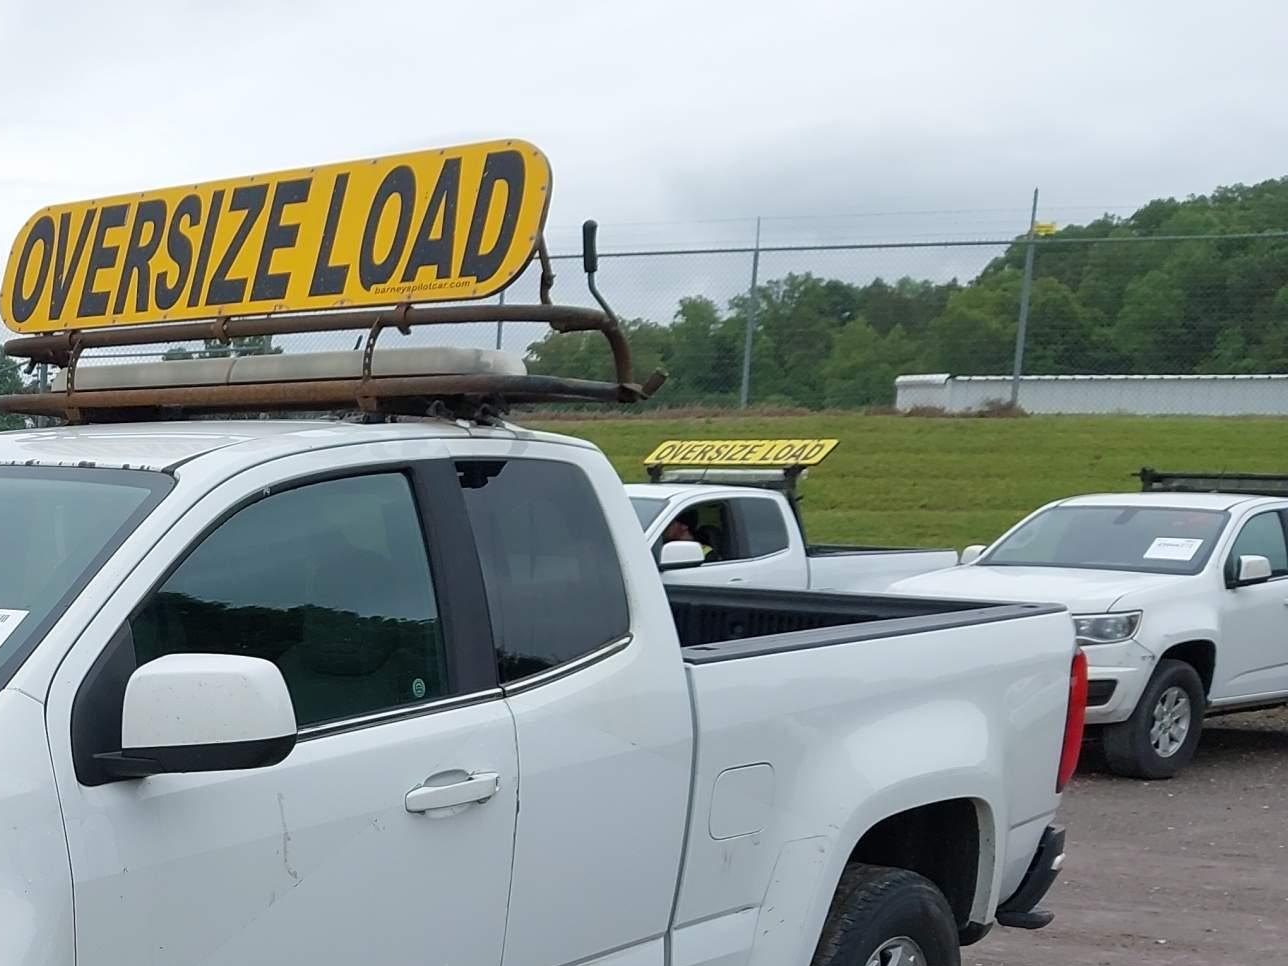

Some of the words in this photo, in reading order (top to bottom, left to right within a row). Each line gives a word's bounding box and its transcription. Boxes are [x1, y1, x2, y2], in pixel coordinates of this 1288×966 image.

[11, 177, 314, 324] OVERSIZE
[307, 149, 527, 297] LOAD
[373, 279, 471, 295] barneyspilotcar.com
[655, 443, 760, 461] OVERSIZE
[759, 443, 825, 461] LOAD
